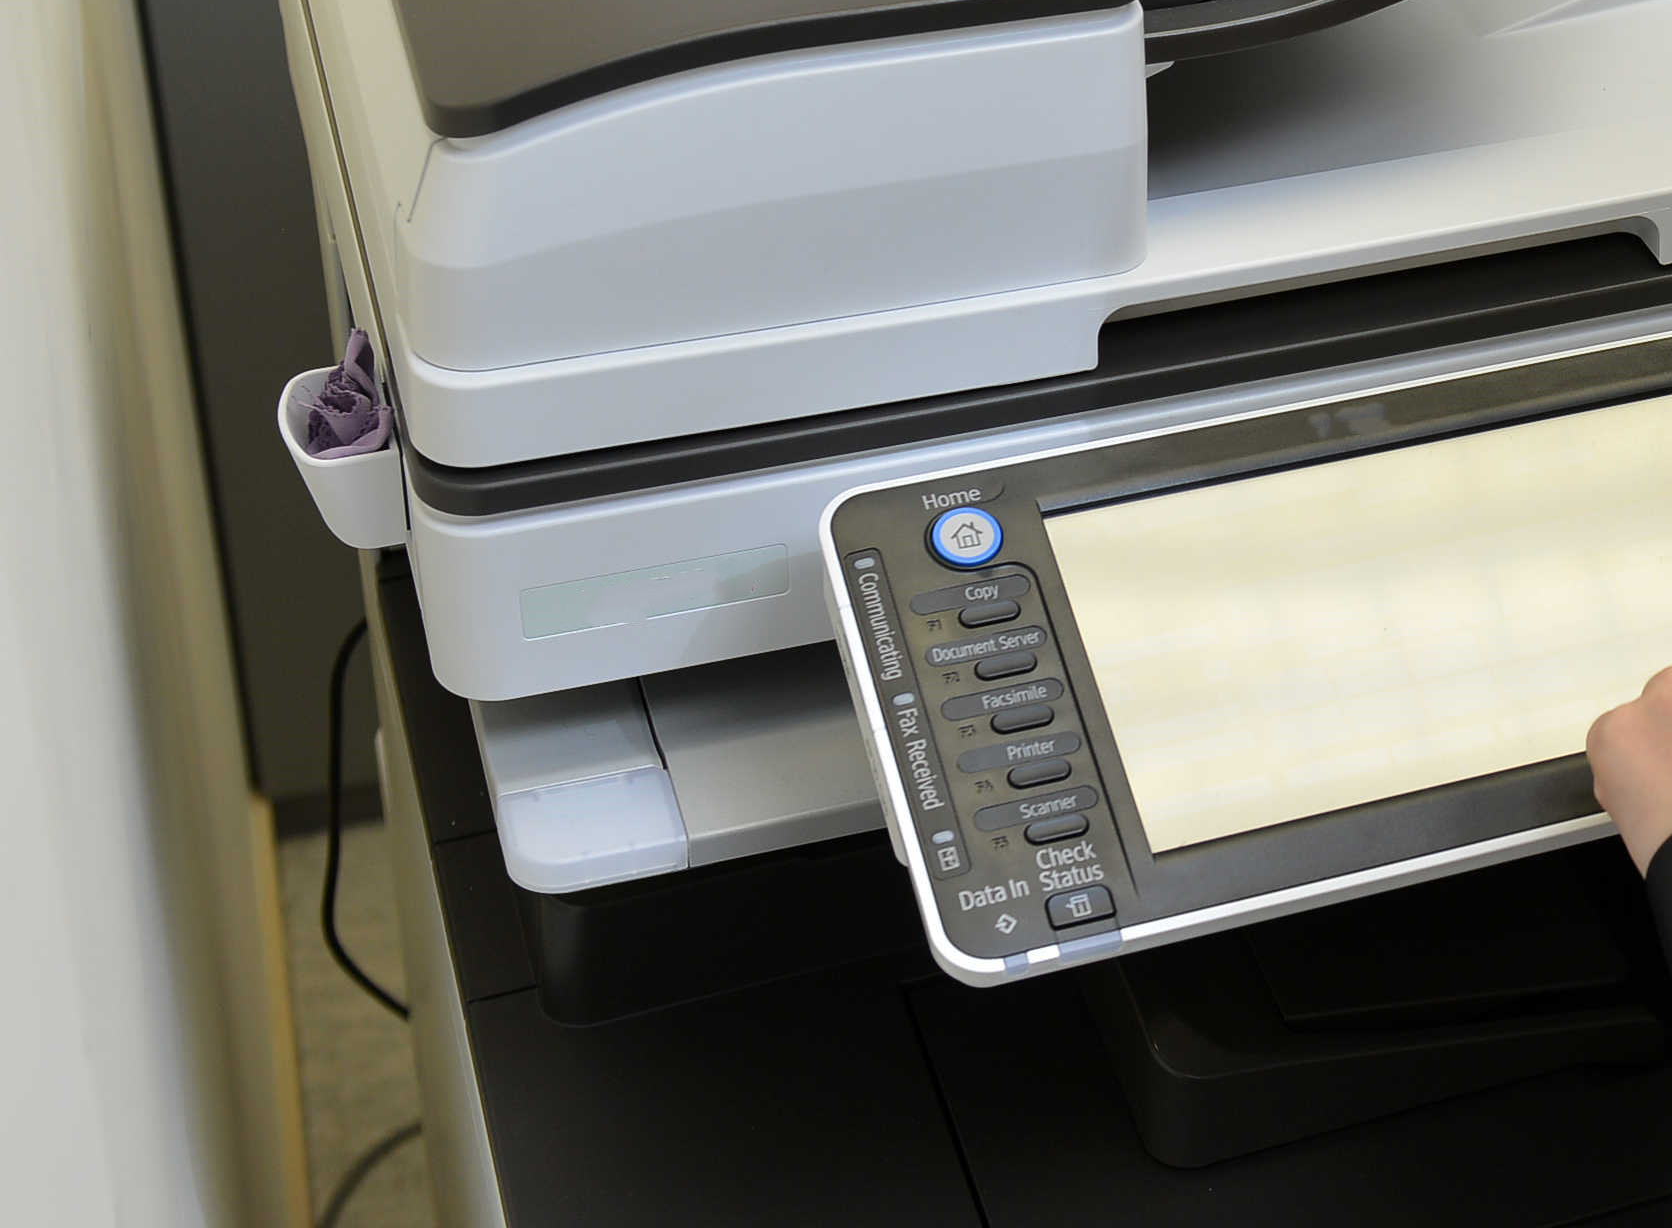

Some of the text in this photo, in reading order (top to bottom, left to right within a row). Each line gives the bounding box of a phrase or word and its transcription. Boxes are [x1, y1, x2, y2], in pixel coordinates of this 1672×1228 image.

[922, 488, 983, 511] Home
[963, 583, 1000, 602] Copy
[857, 572, 904, 682] Communicating
[931, 629, 1042, 664] Document Server
[980, 684, 1050, 710] Facsimile
[895, 706, 946, 812] Fax Received
[1006, 738, 1057, 761] Printer
[1018, 793, 1079, 820] Scanner
[1035, 839, 1098, 871] Check
[1038, 862, 1106, 893] Status
[958, 878, 1032, 912] Data In
